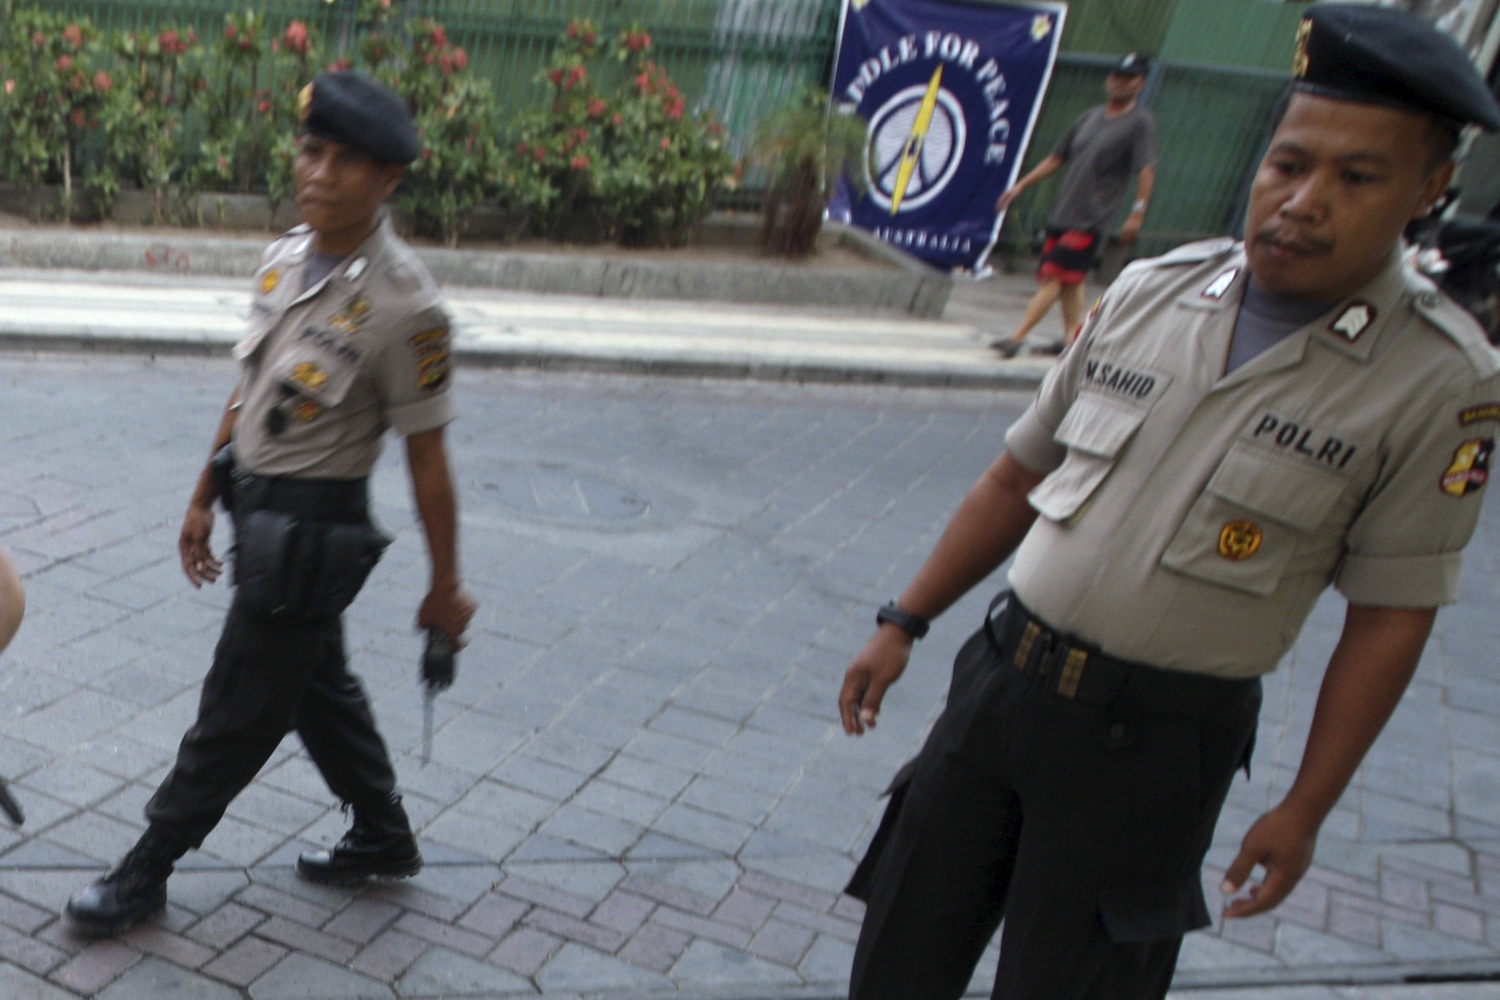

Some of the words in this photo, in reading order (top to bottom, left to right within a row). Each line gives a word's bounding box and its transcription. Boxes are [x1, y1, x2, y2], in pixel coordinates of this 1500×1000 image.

[924, 30, 980, 70] FOR
[975, 57, 1011, 167] PEACE
[1253, 414, 1357, 470] POLRI
